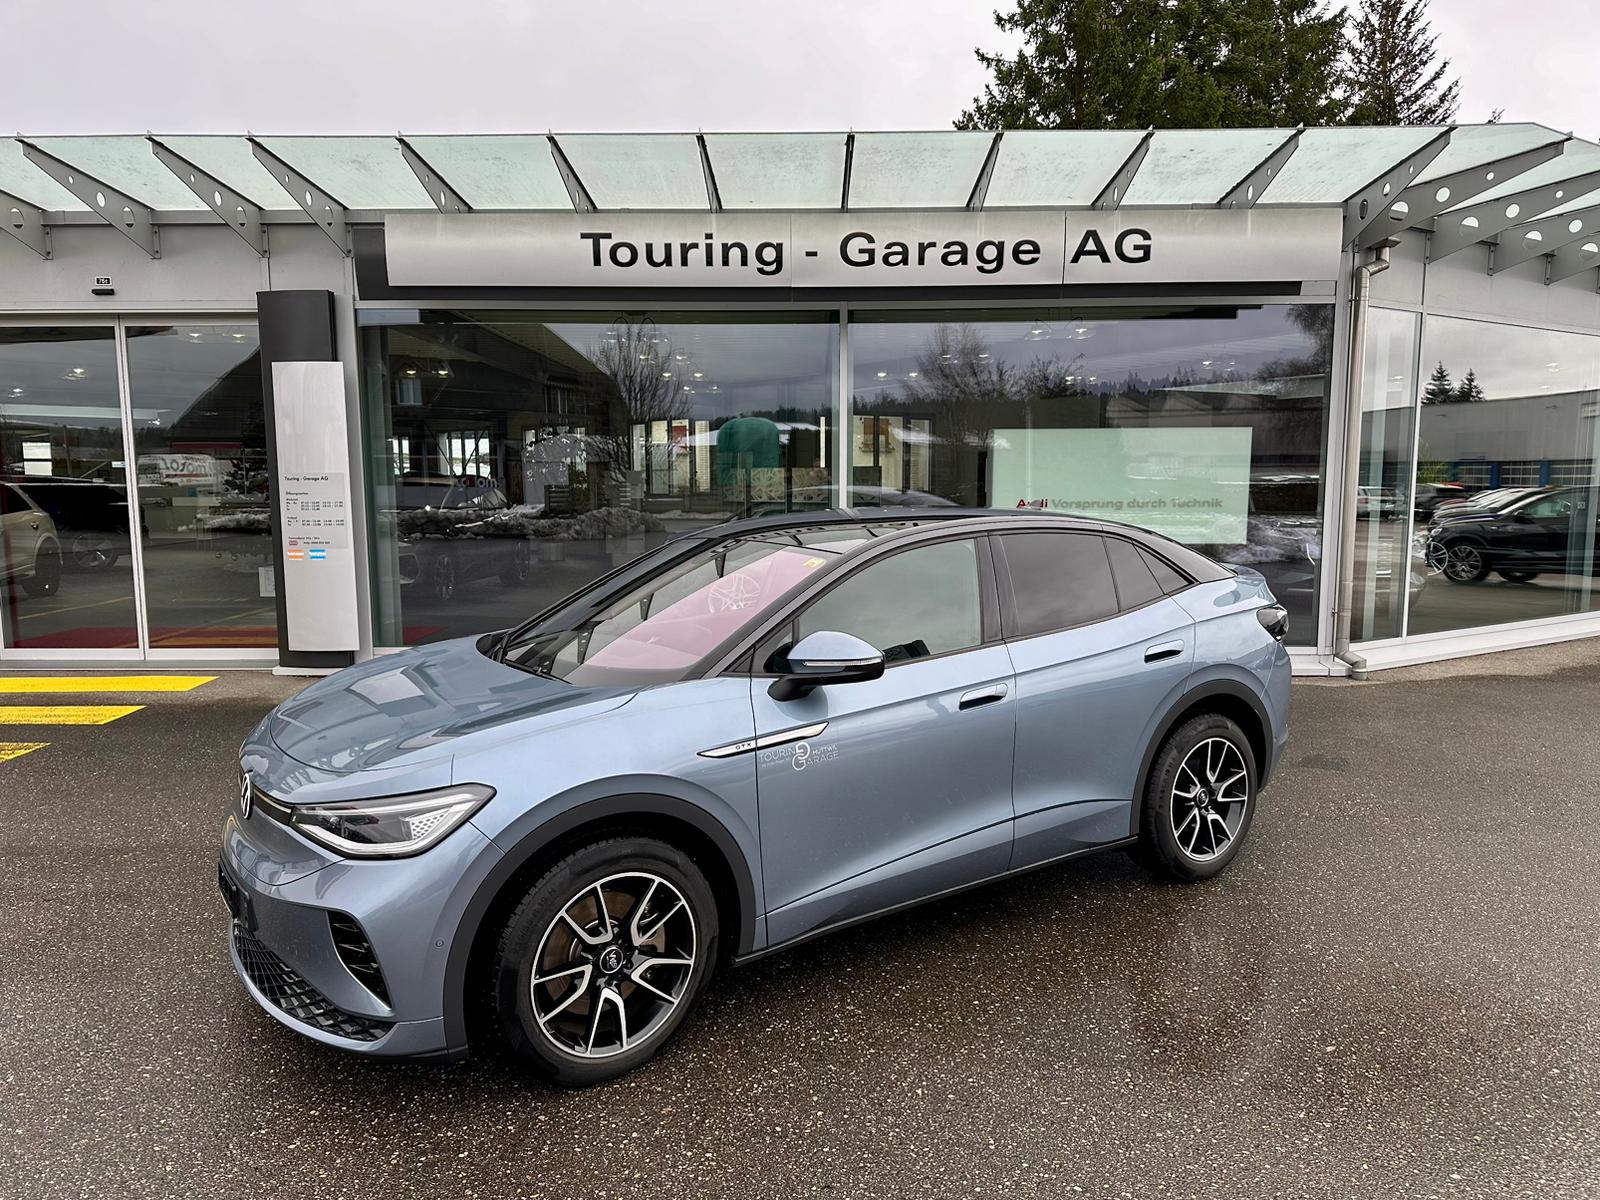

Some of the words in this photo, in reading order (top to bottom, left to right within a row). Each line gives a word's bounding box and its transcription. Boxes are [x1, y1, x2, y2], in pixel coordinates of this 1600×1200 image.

[580, 231, 785, 275] Touring
[805, 249, 818, 257] -
[839, 231, 1042, 274] Garage
[1070, 228, 1153, 264] AG
[1052, 498, 1123, 511] Vorsprung
[1127, 498, 1166, 509] durch
[735, 742, 752, 750] GTX
